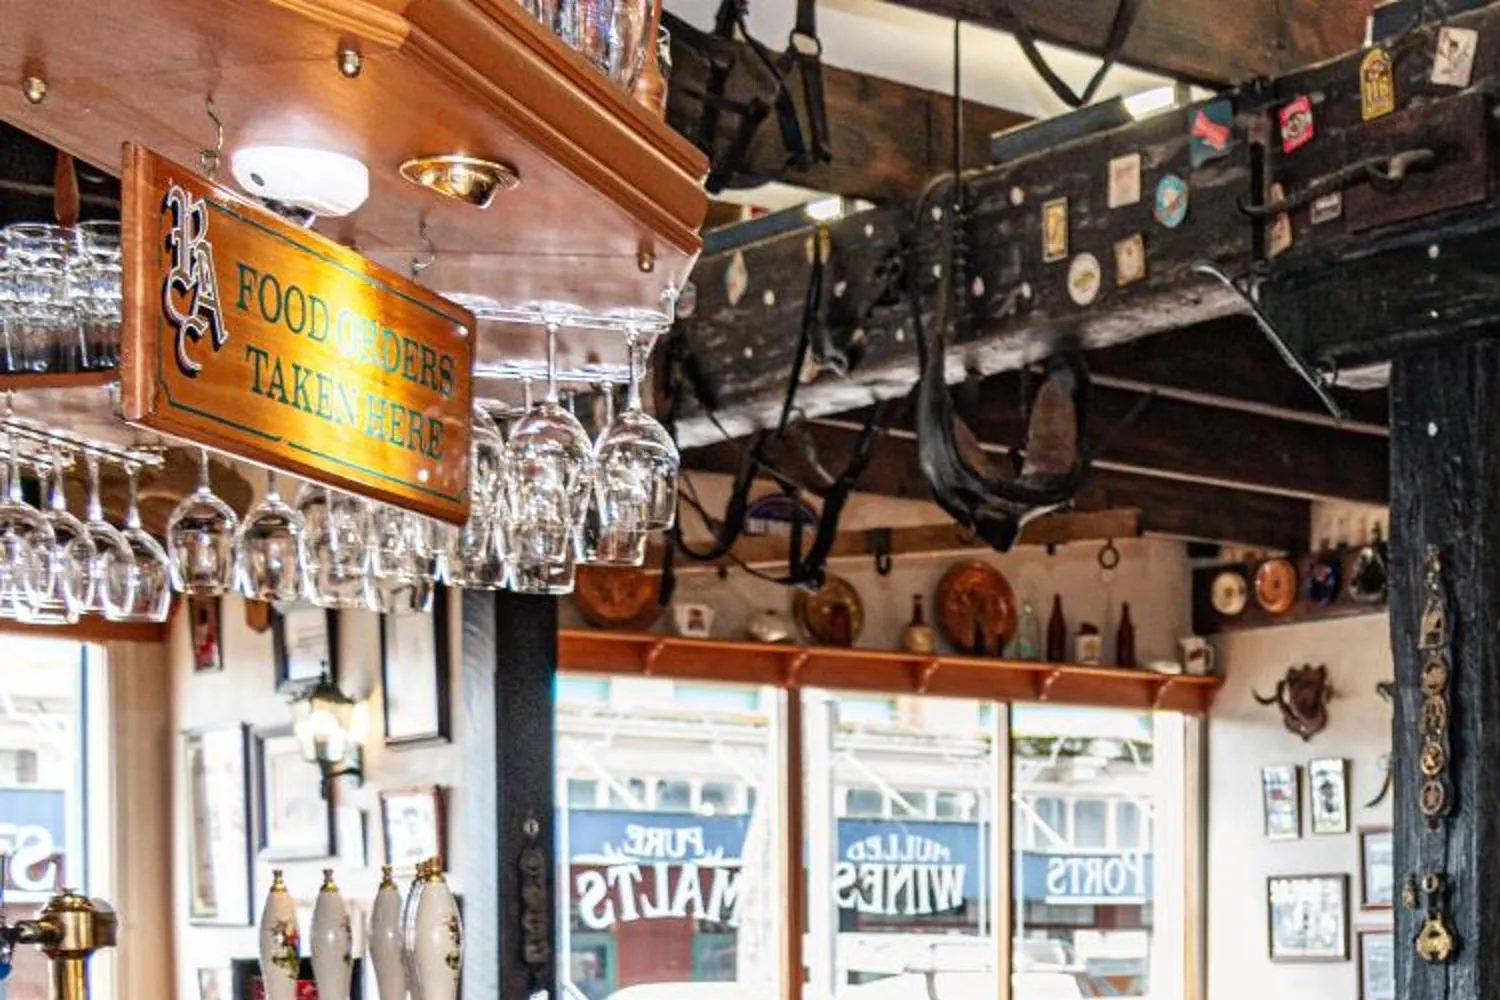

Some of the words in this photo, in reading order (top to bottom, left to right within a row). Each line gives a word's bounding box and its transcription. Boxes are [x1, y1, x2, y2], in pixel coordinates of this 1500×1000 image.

[236, 261, 329, 343] FOOD
[337, 307, 455, 398] ORDERS
[246, 343, 355, 427] TAKEN
[364, 392, 445, 461] HERE
